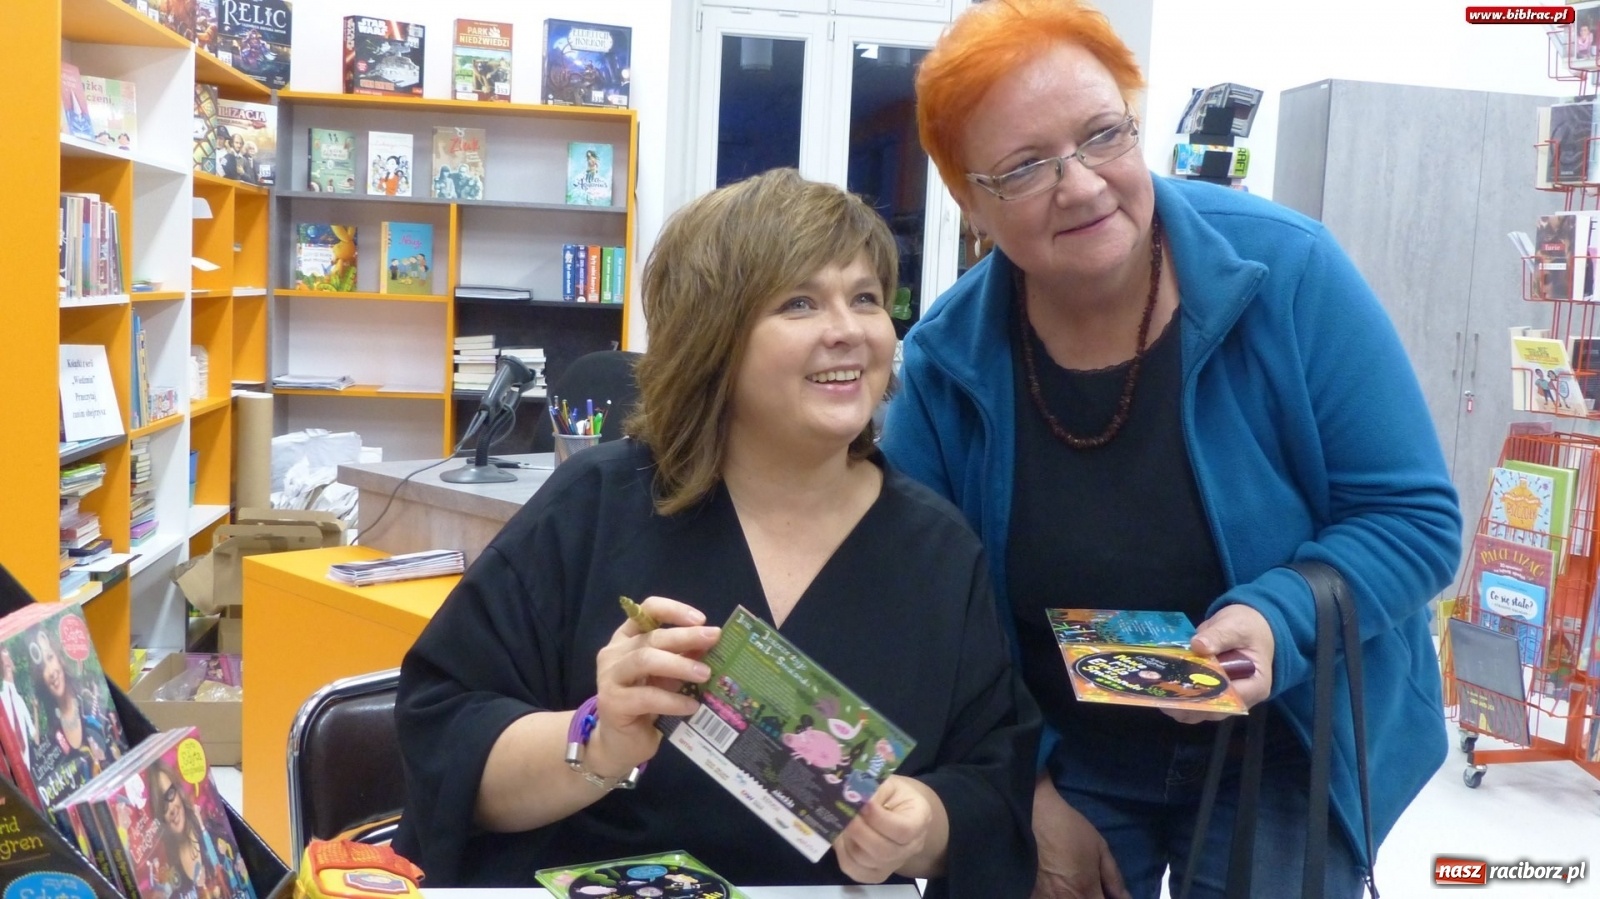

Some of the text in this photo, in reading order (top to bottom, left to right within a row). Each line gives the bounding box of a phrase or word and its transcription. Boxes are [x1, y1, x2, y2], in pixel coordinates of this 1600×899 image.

[222, 0, 287, 29] RELIC
[467, 26, 489, 36] PARK
[1480, 548, 1508, 565] PALCE
[1490, 590, 1499, 601] Co
